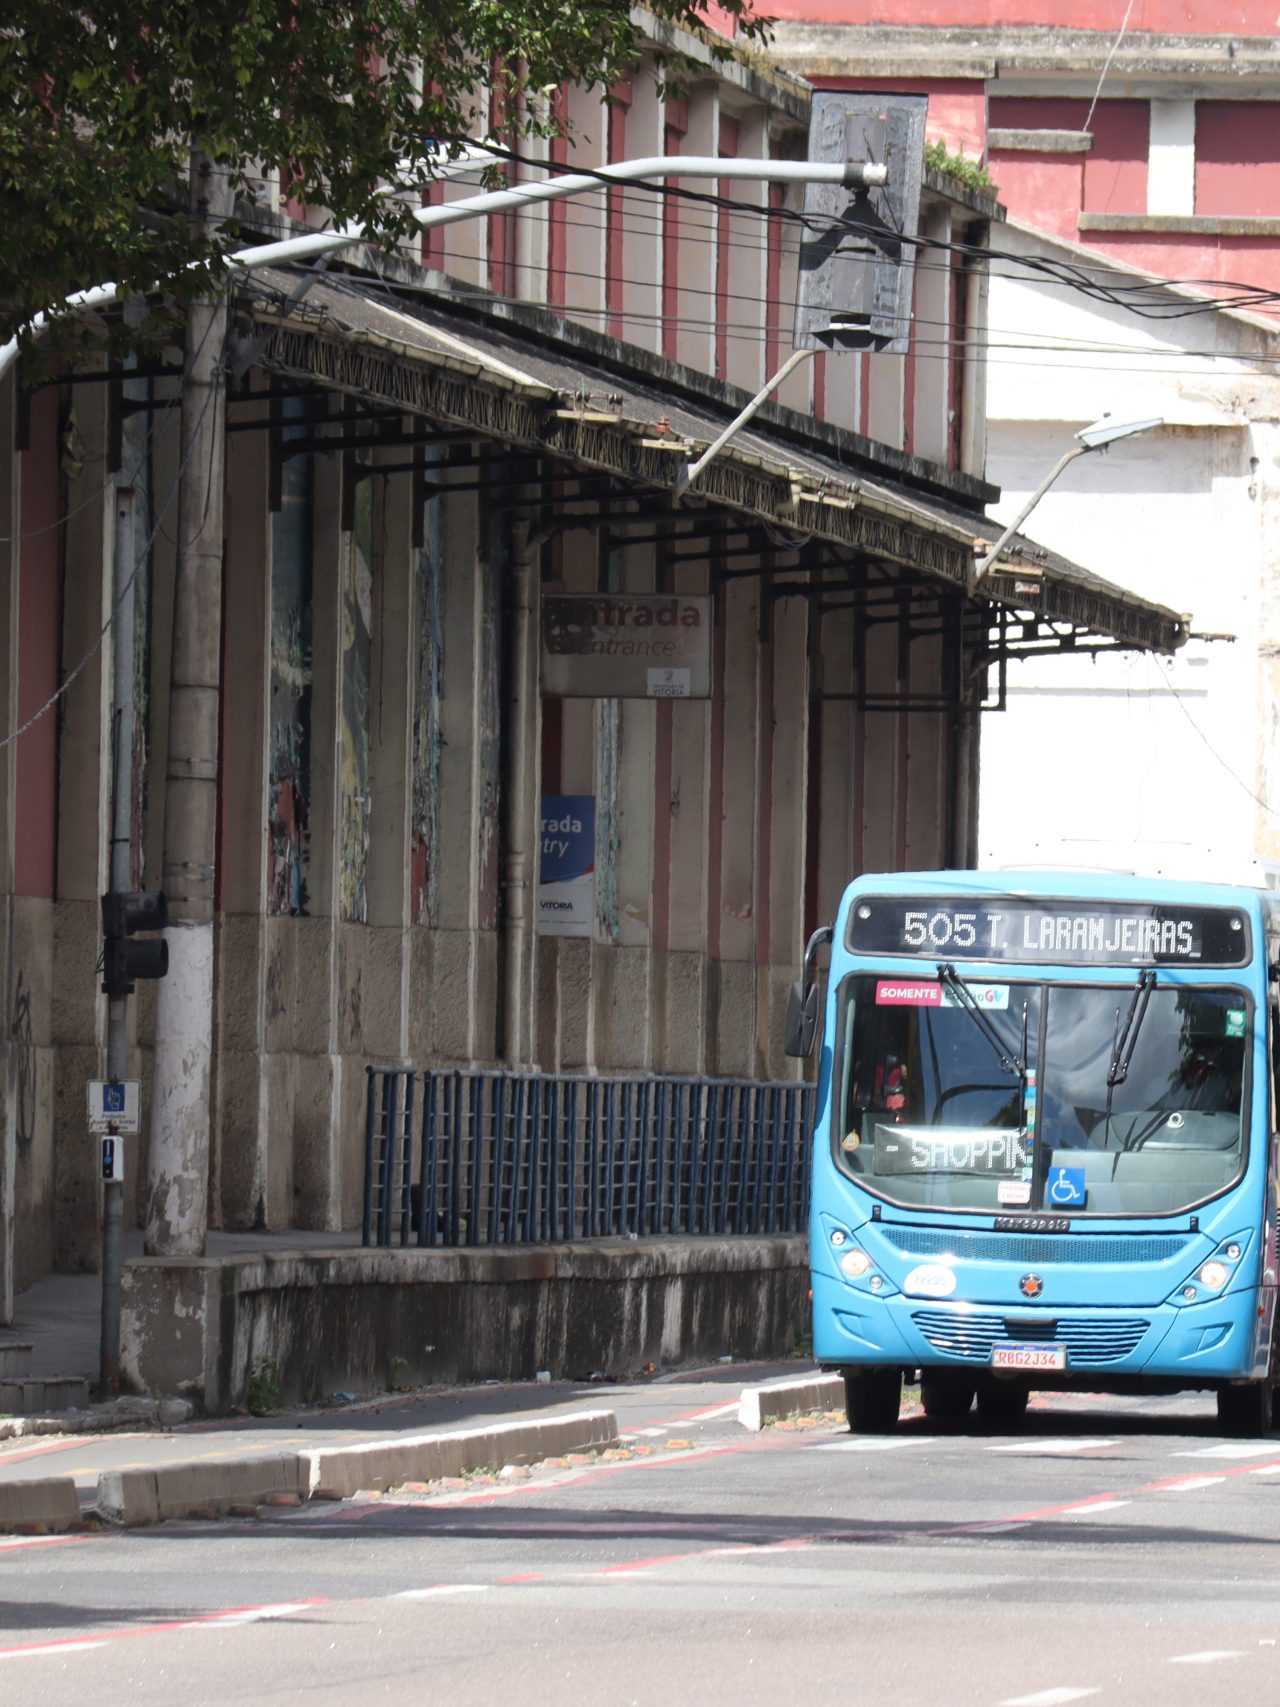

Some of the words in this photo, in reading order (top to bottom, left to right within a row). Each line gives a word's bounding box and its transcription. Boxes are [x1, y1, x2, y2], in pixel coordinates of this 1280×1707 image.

[904, 912, 976, 947] 505
[987, 914, 1009, 948] T.
[1023, 915, 1193, 954] LARANJEIRAS
[880, 987, 938, 999] SOMENTE
[999, 1351, 1057, 1366] RBG2J34
